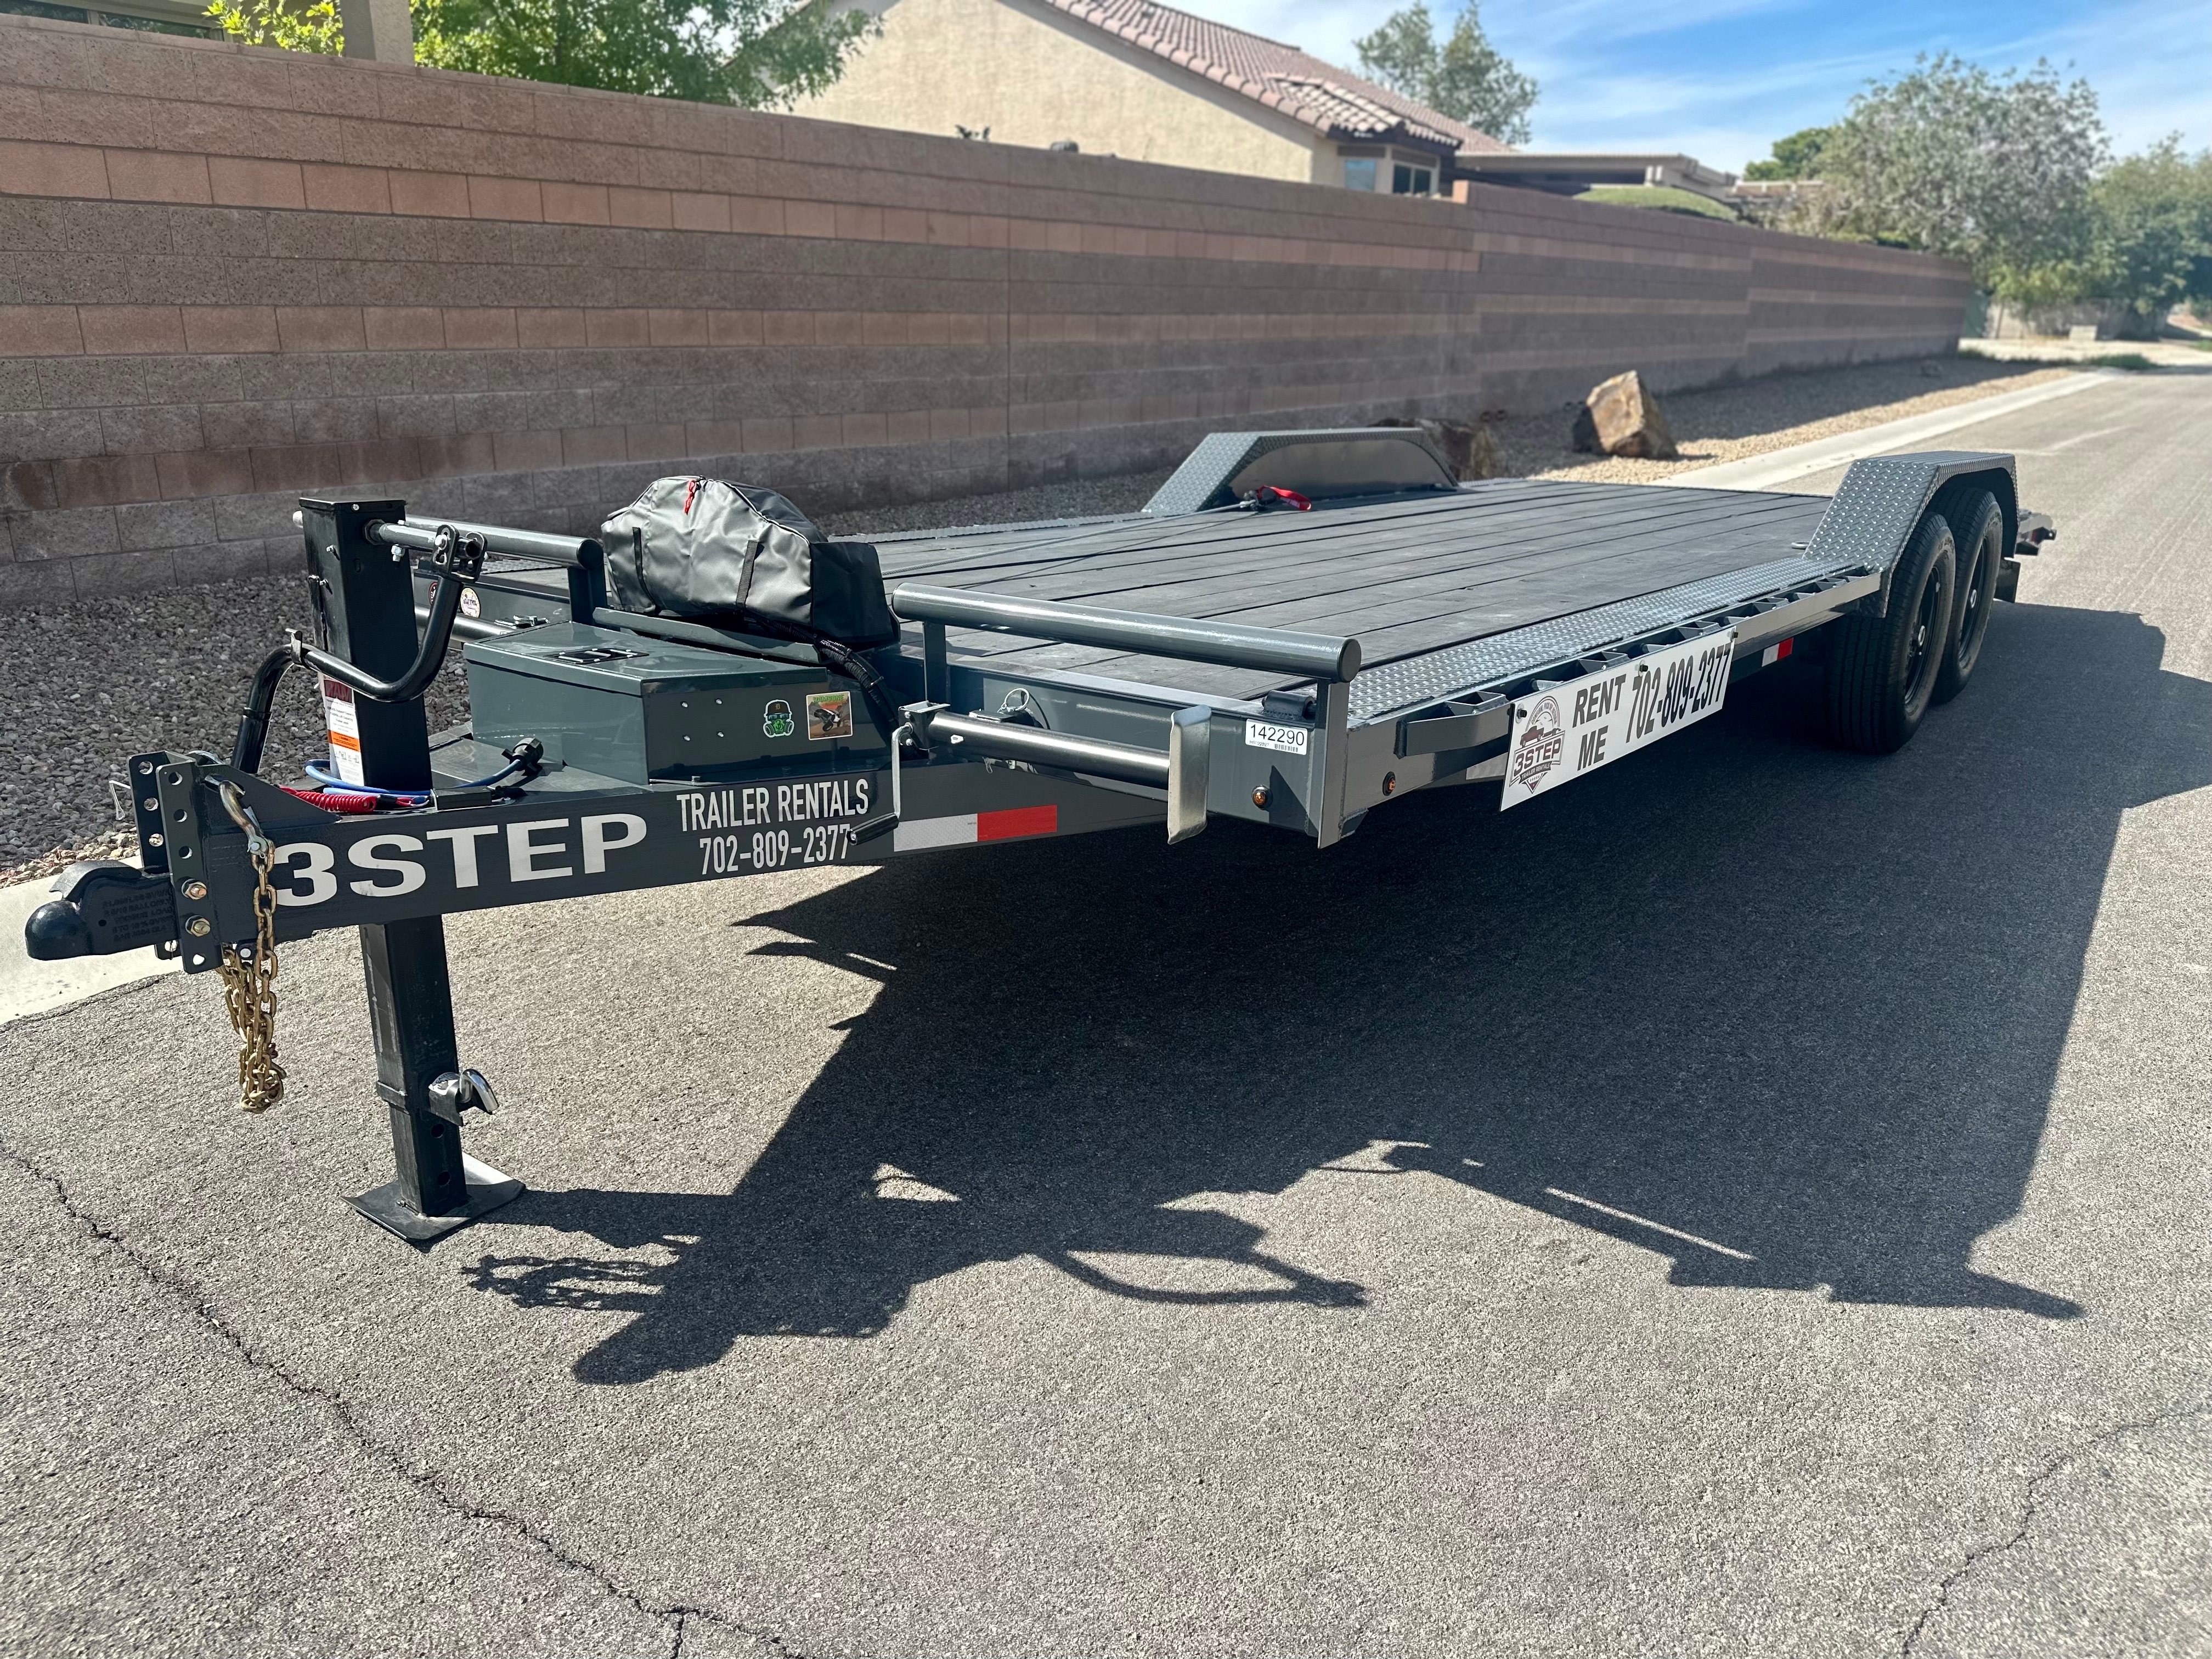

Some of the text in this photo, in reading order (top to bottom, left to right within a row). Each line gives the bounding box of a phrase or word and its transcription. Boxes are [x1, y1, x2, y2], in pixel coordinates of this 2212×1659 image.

[1572, 642, 1732, 743] RENT 702-809-2377
[1251, 724, 1305, 746] 142290
[1514, 738, 1561, 777] 3STEP
[1577, 725, 1609, 771] ME
[1521, 762, 1550, 780] TRAILER RENTALS
[676, 778, 869, 832] TRAILER RENTALS
[274, 813, 647, 906] 3STEP
[699, 823, 850, 875] 702-809-2377
